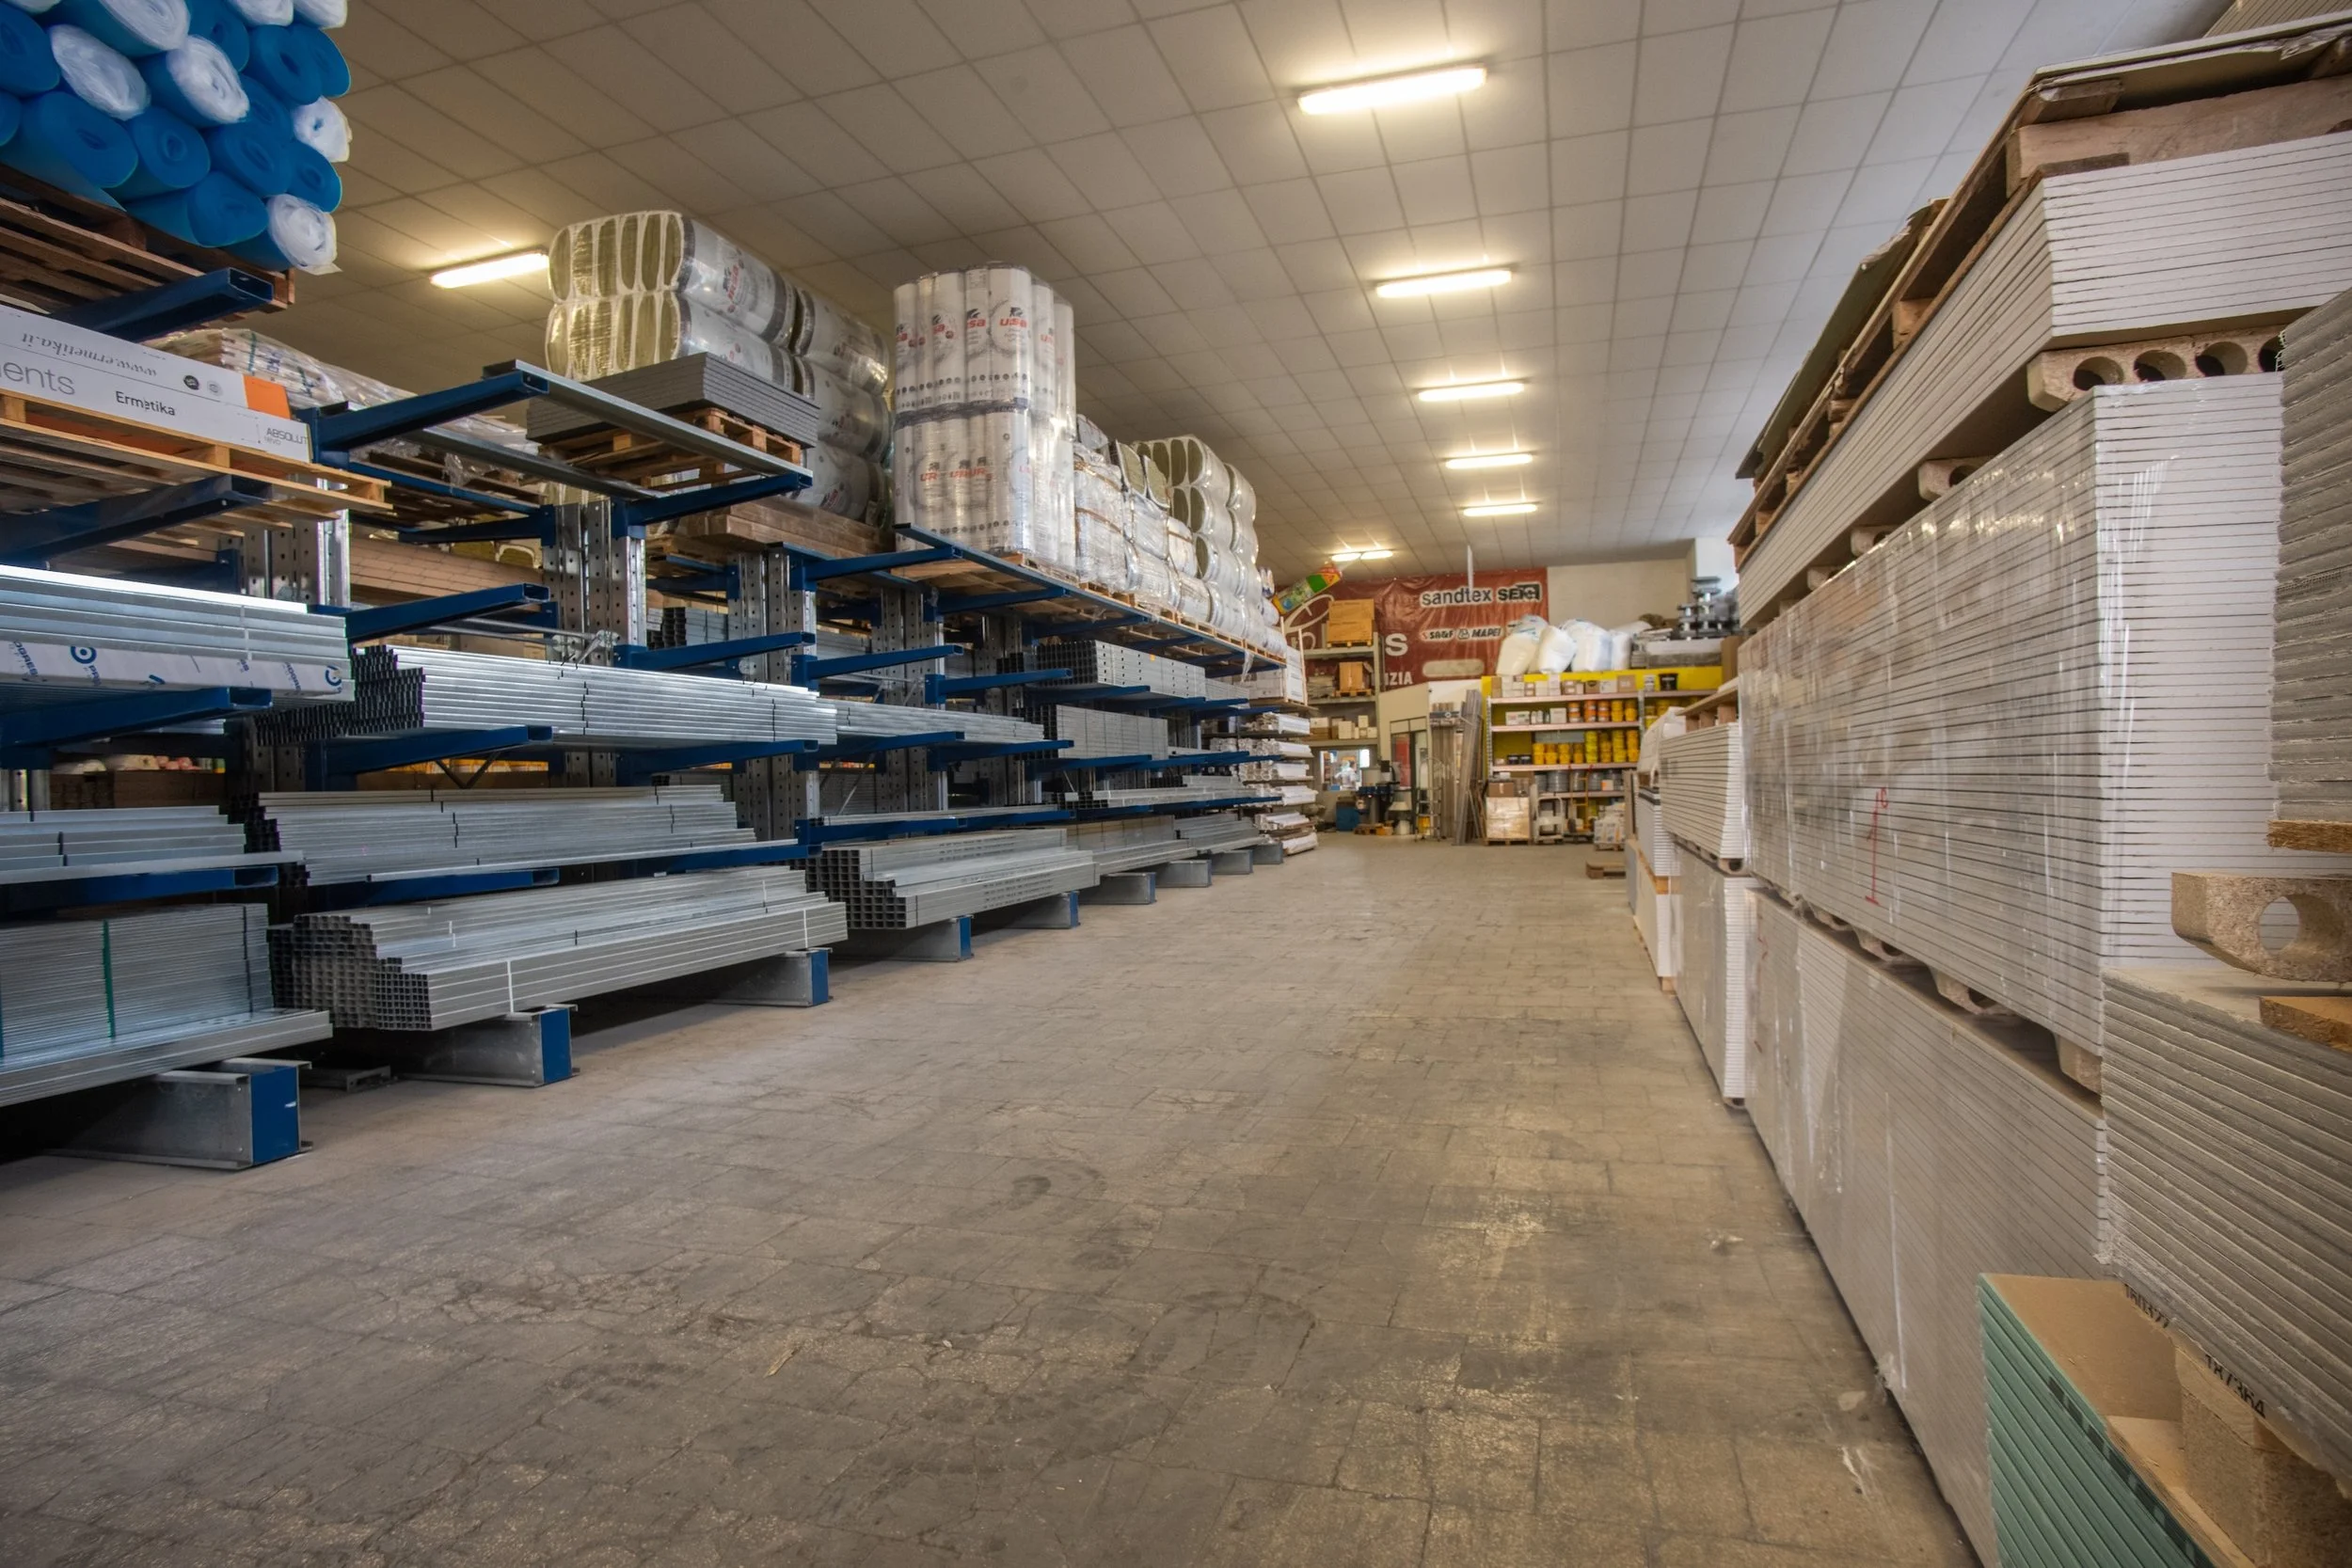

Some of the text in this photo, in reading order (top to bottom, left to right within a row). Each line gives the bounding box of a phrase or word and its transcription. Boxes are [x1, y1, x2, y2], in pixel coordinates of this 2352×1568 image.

[0, 361, 75, 396] ents
[115, 390, 176, 417] Ermetika
[1422, 587, 1492, 606] sandtex
[1471, 627, 1502, 639] MAPEI
[1385, 632, 1408, 657] S
[1385, 671, 1413, 687] IZIA
